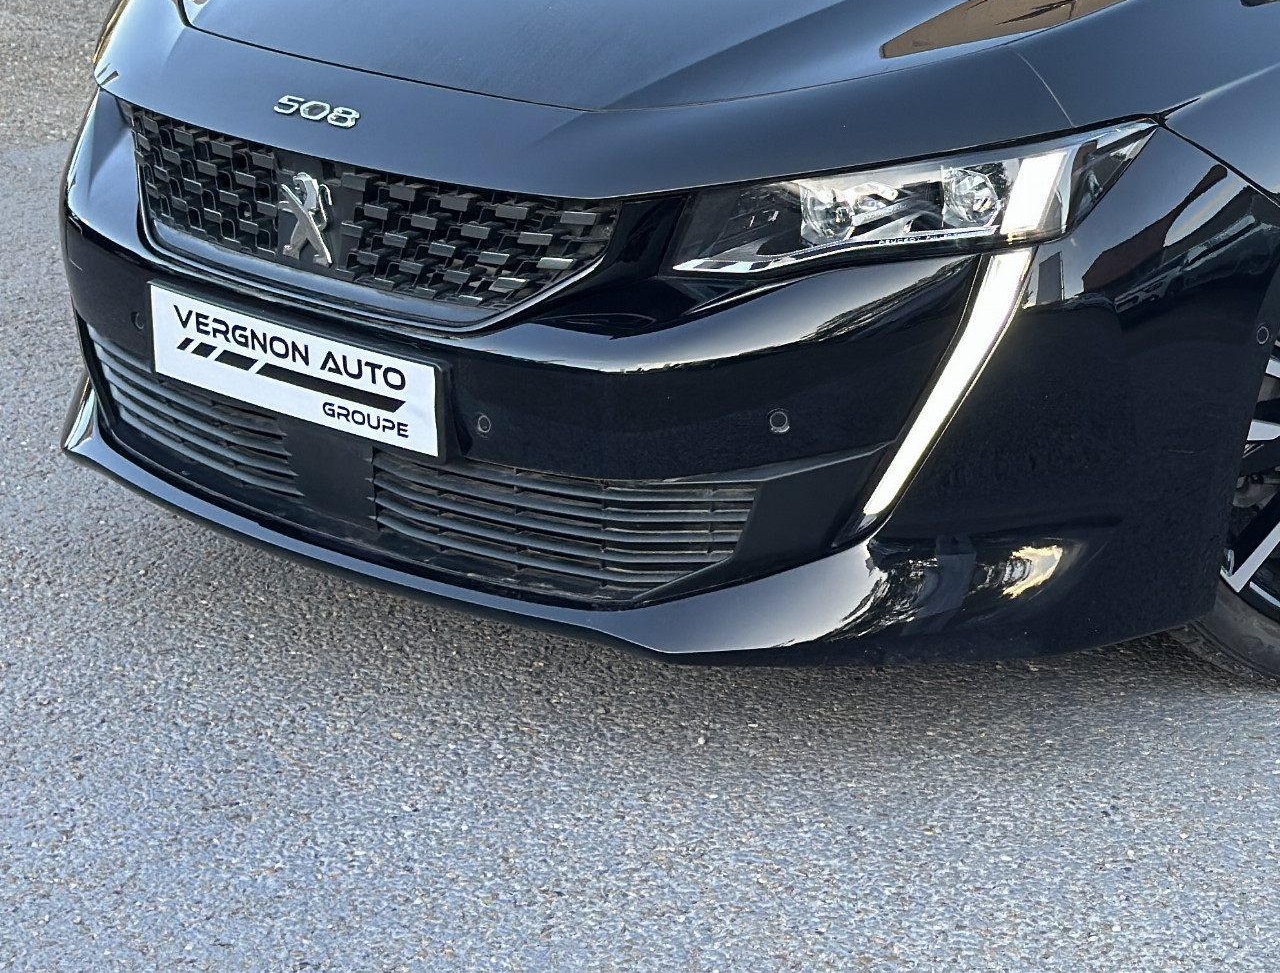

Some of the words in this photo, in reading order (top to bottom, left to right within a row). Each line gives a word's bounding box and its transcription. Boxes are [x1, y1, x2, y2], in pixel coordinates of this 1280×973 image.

[273, 94, 361, 129] 508
[173, 304, 310, 367] VERGNON
[320, 350, 407, 391] AUTO
[322, 401, 410, 439] GROUPE
